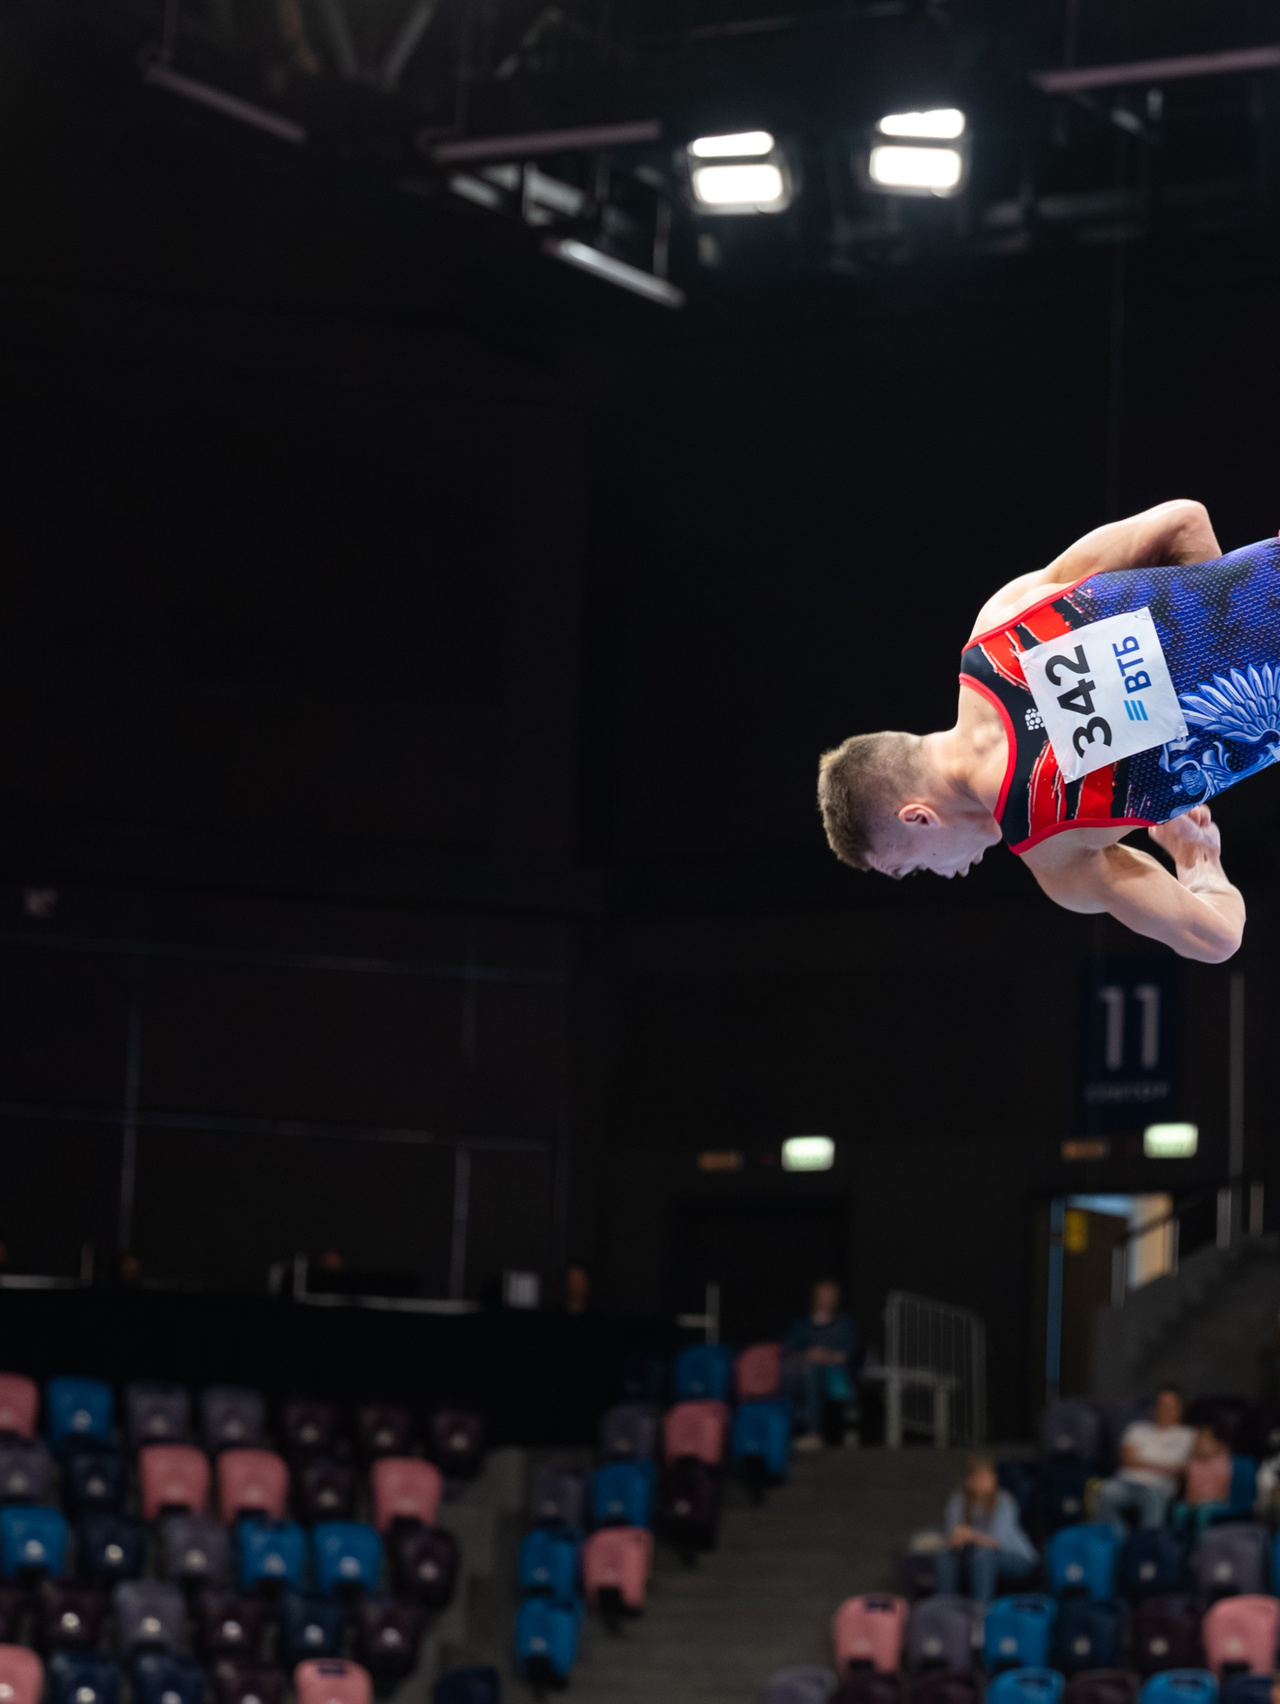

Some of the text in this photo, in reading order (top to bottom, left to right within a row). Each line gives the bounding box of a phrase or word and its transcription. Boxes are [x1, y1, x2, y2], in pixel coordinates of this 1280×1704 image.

[1045, 644, 1112, 758] 342
[1112, 635, 1152, 694] ВТБ
[1098, 985, 1161, 1071] 11
